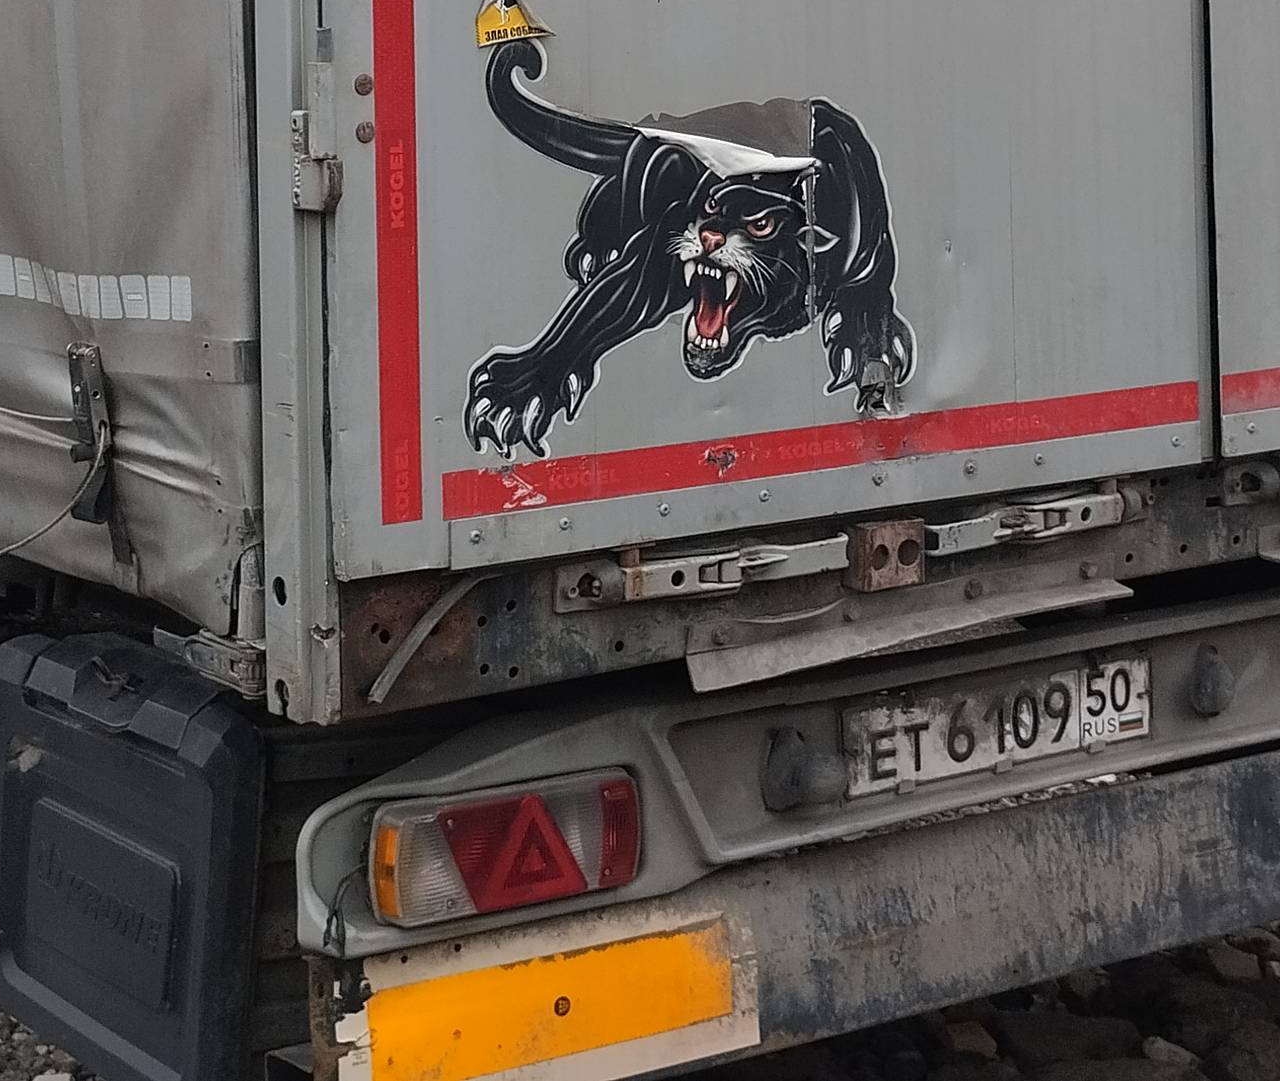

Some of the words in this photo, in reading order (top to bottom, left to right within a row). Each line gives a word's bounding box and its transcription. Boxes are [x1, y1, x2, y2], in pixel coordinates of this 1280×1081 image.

[484, 28, 509, 42] ЗЛАЯ
[1085, 668, 1131, 717] 50
[1082, 716, 1117, 738] RUS
